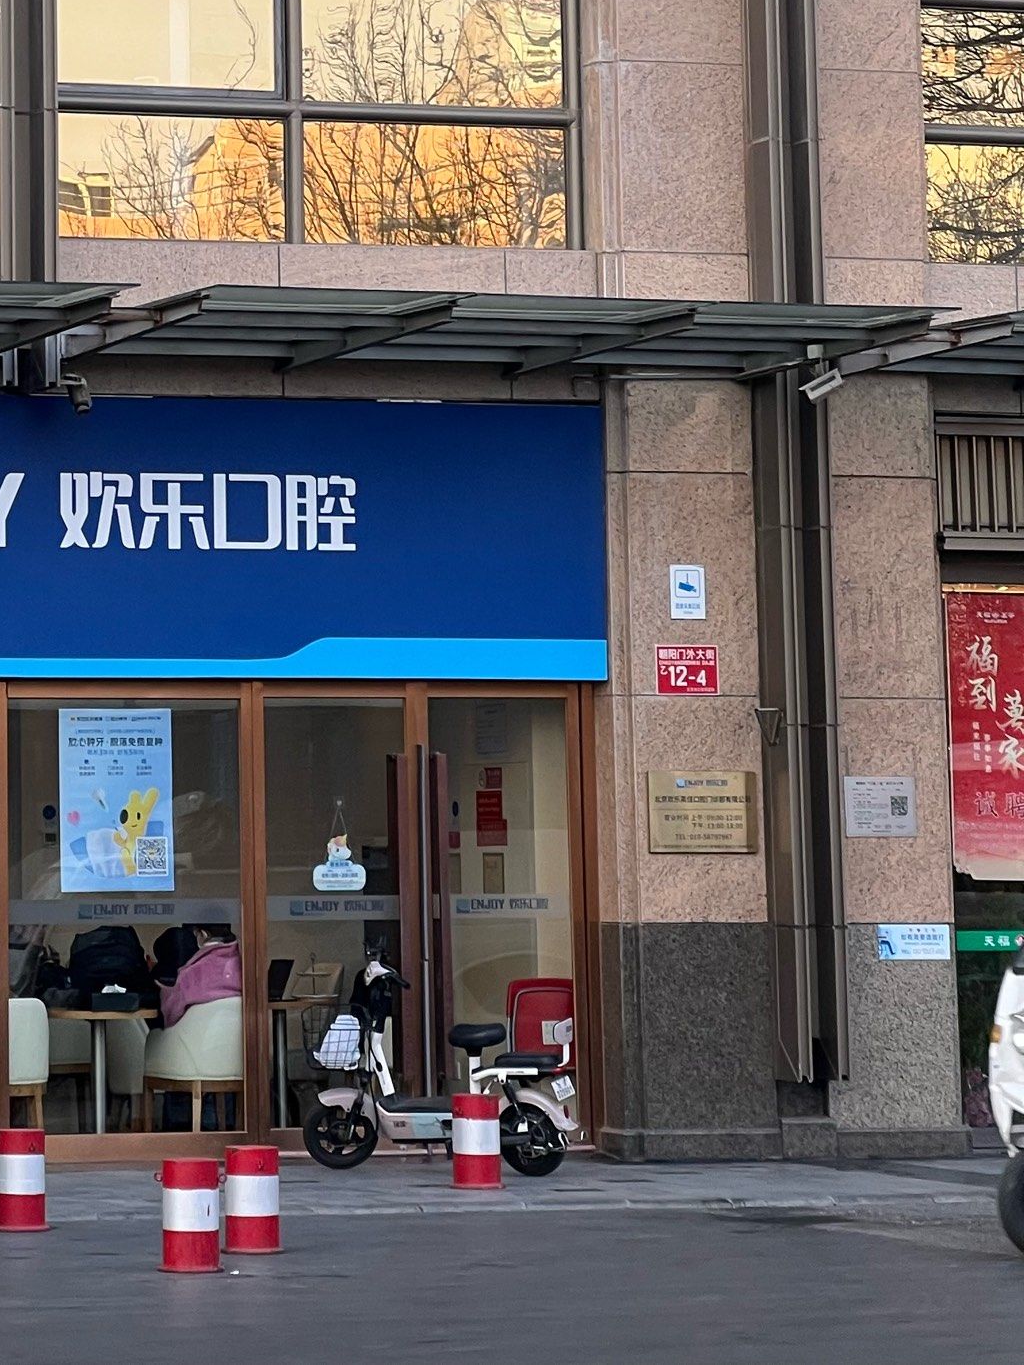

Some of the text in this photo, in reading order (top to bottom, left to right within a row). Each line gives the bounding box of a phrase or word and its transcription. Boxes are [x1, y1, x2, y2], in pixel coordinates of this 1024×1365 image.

[59, 472, 356, 551] 欢乐口腔
[659, 649, 714, 660] 朝阳门外大街
[94, 904, 129, 915] ENJOY
[305, 901, 339, 911] ENJOY
[471, 899, 505, 909] ENJOY
